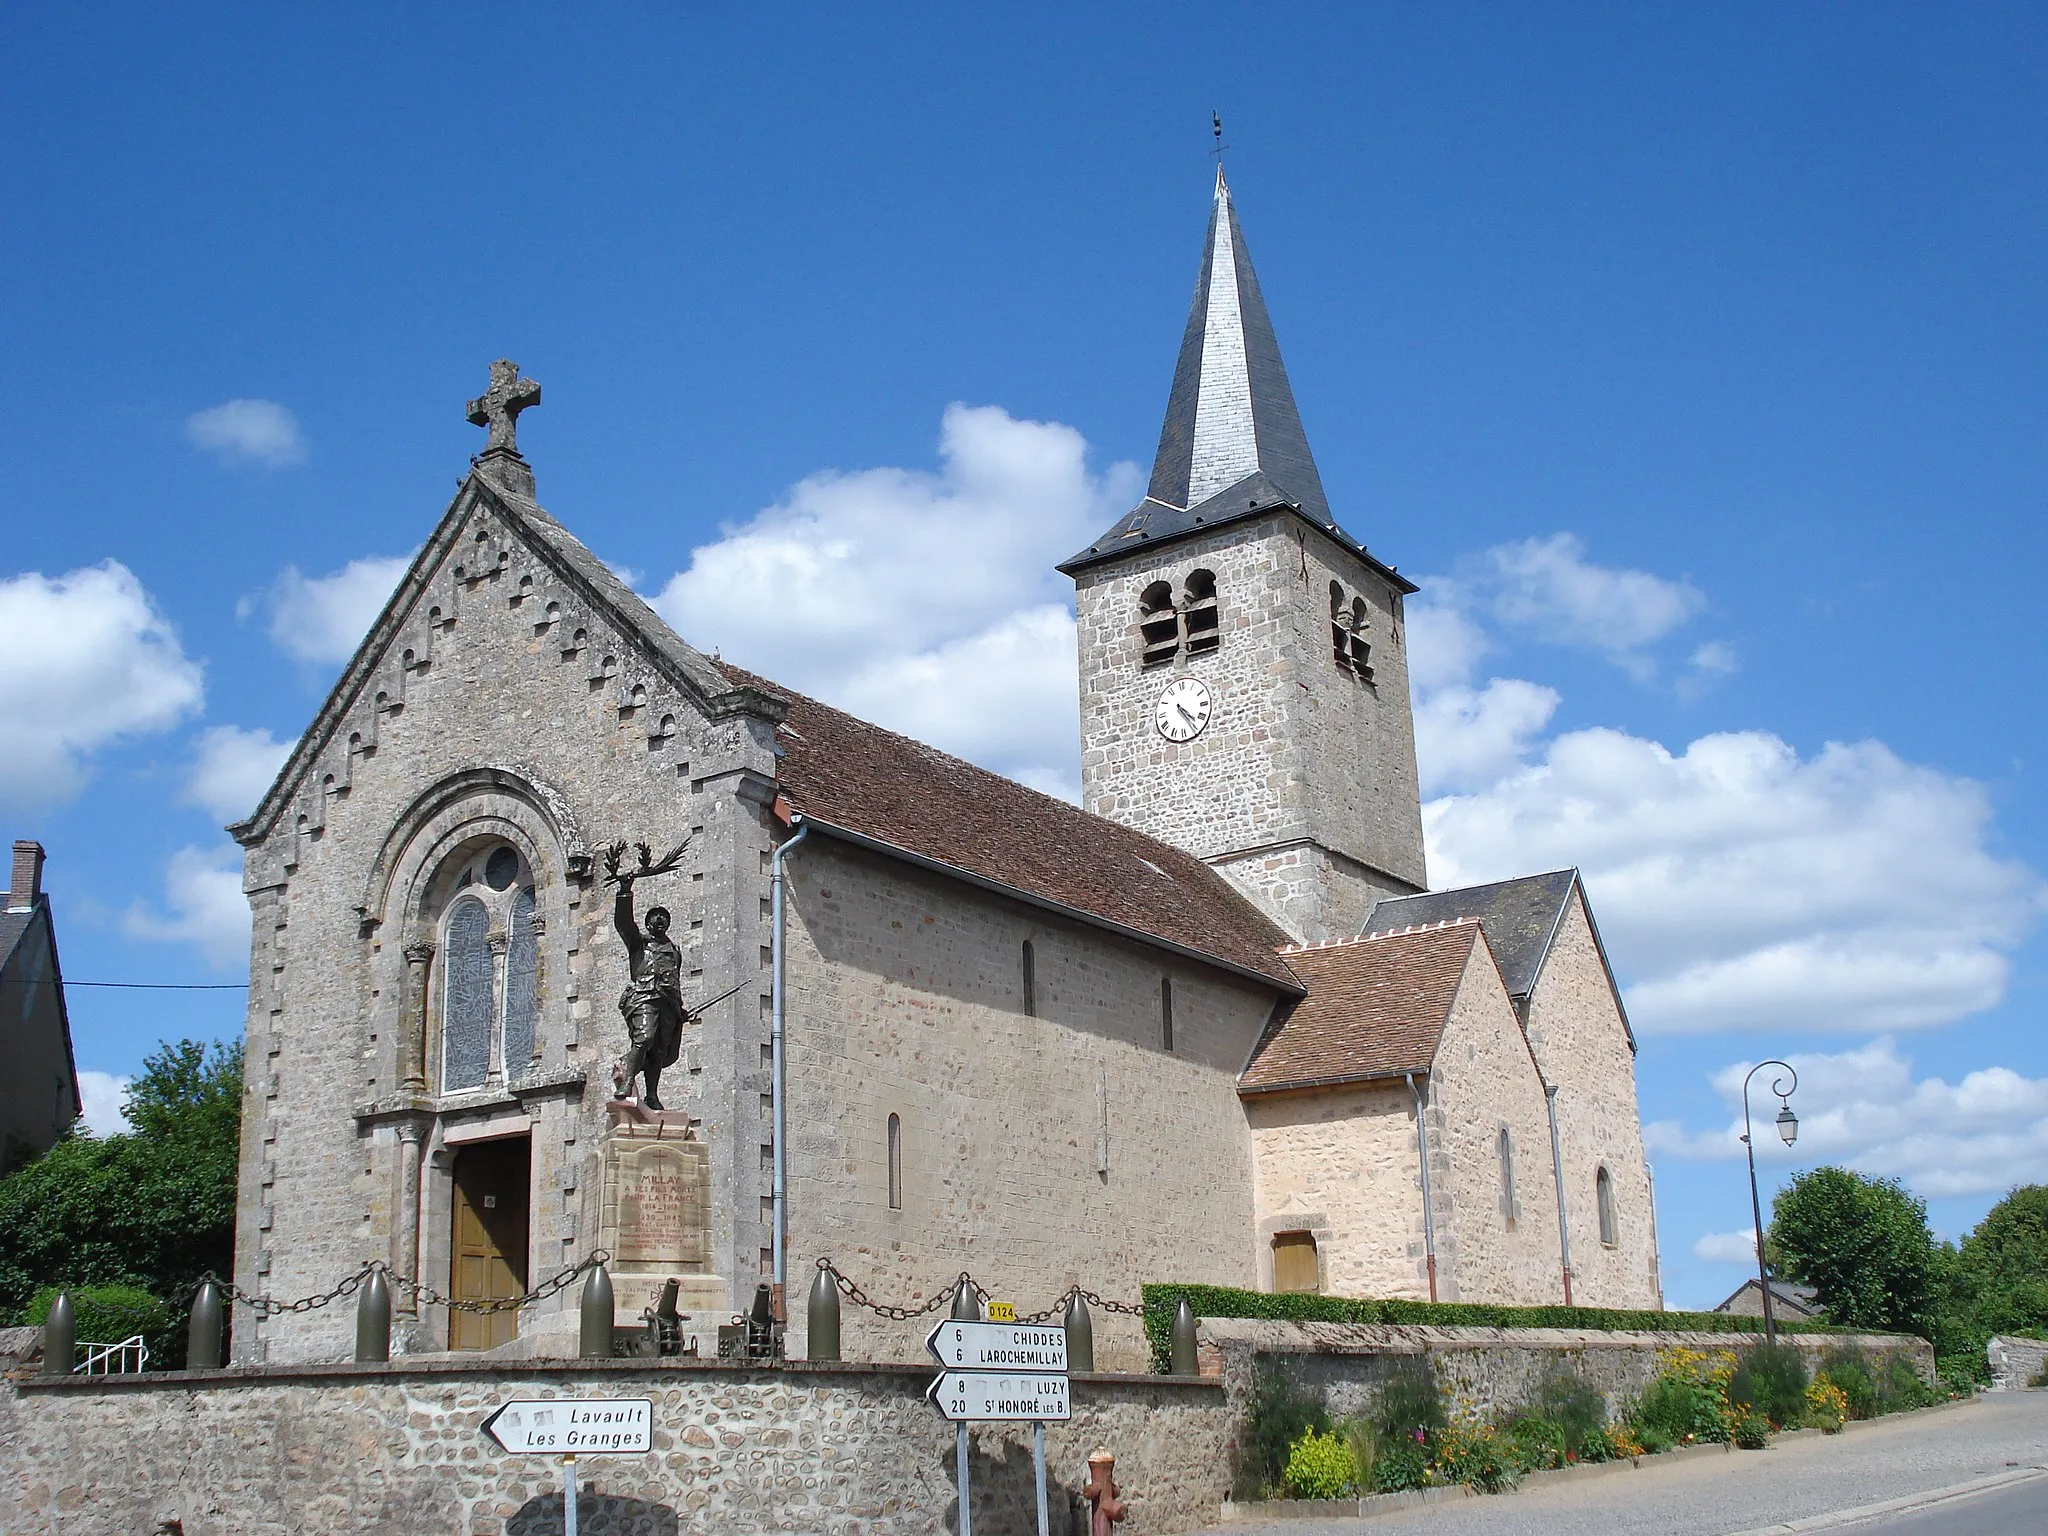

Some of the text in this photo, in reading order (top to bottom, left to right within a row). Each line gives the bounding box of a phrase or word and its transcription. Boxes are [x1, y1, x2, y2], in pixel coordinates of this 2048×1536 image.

[641, 1175, 680, 1184] MILLAY
[663, 1193, 695, 1202] FRANCE
[990, 1306, 1013, 1317] D 124
[955, 1329, 1063, 1346] 6 CHIDDES
[956, 1349, 1063, 1365] 6 LAROCHEMILLAY
[958, 1380, 1065, 1394] 8 LUZY
[951, 1400, 966, 1413] 20
[998, 1398, 1039, 1413] HONORÉ
[1043, 1405, 1054, 1413] LES
[571, 1408, 643, 1423] Lavault
[527, 1431, 642, 1448] Les Granges
